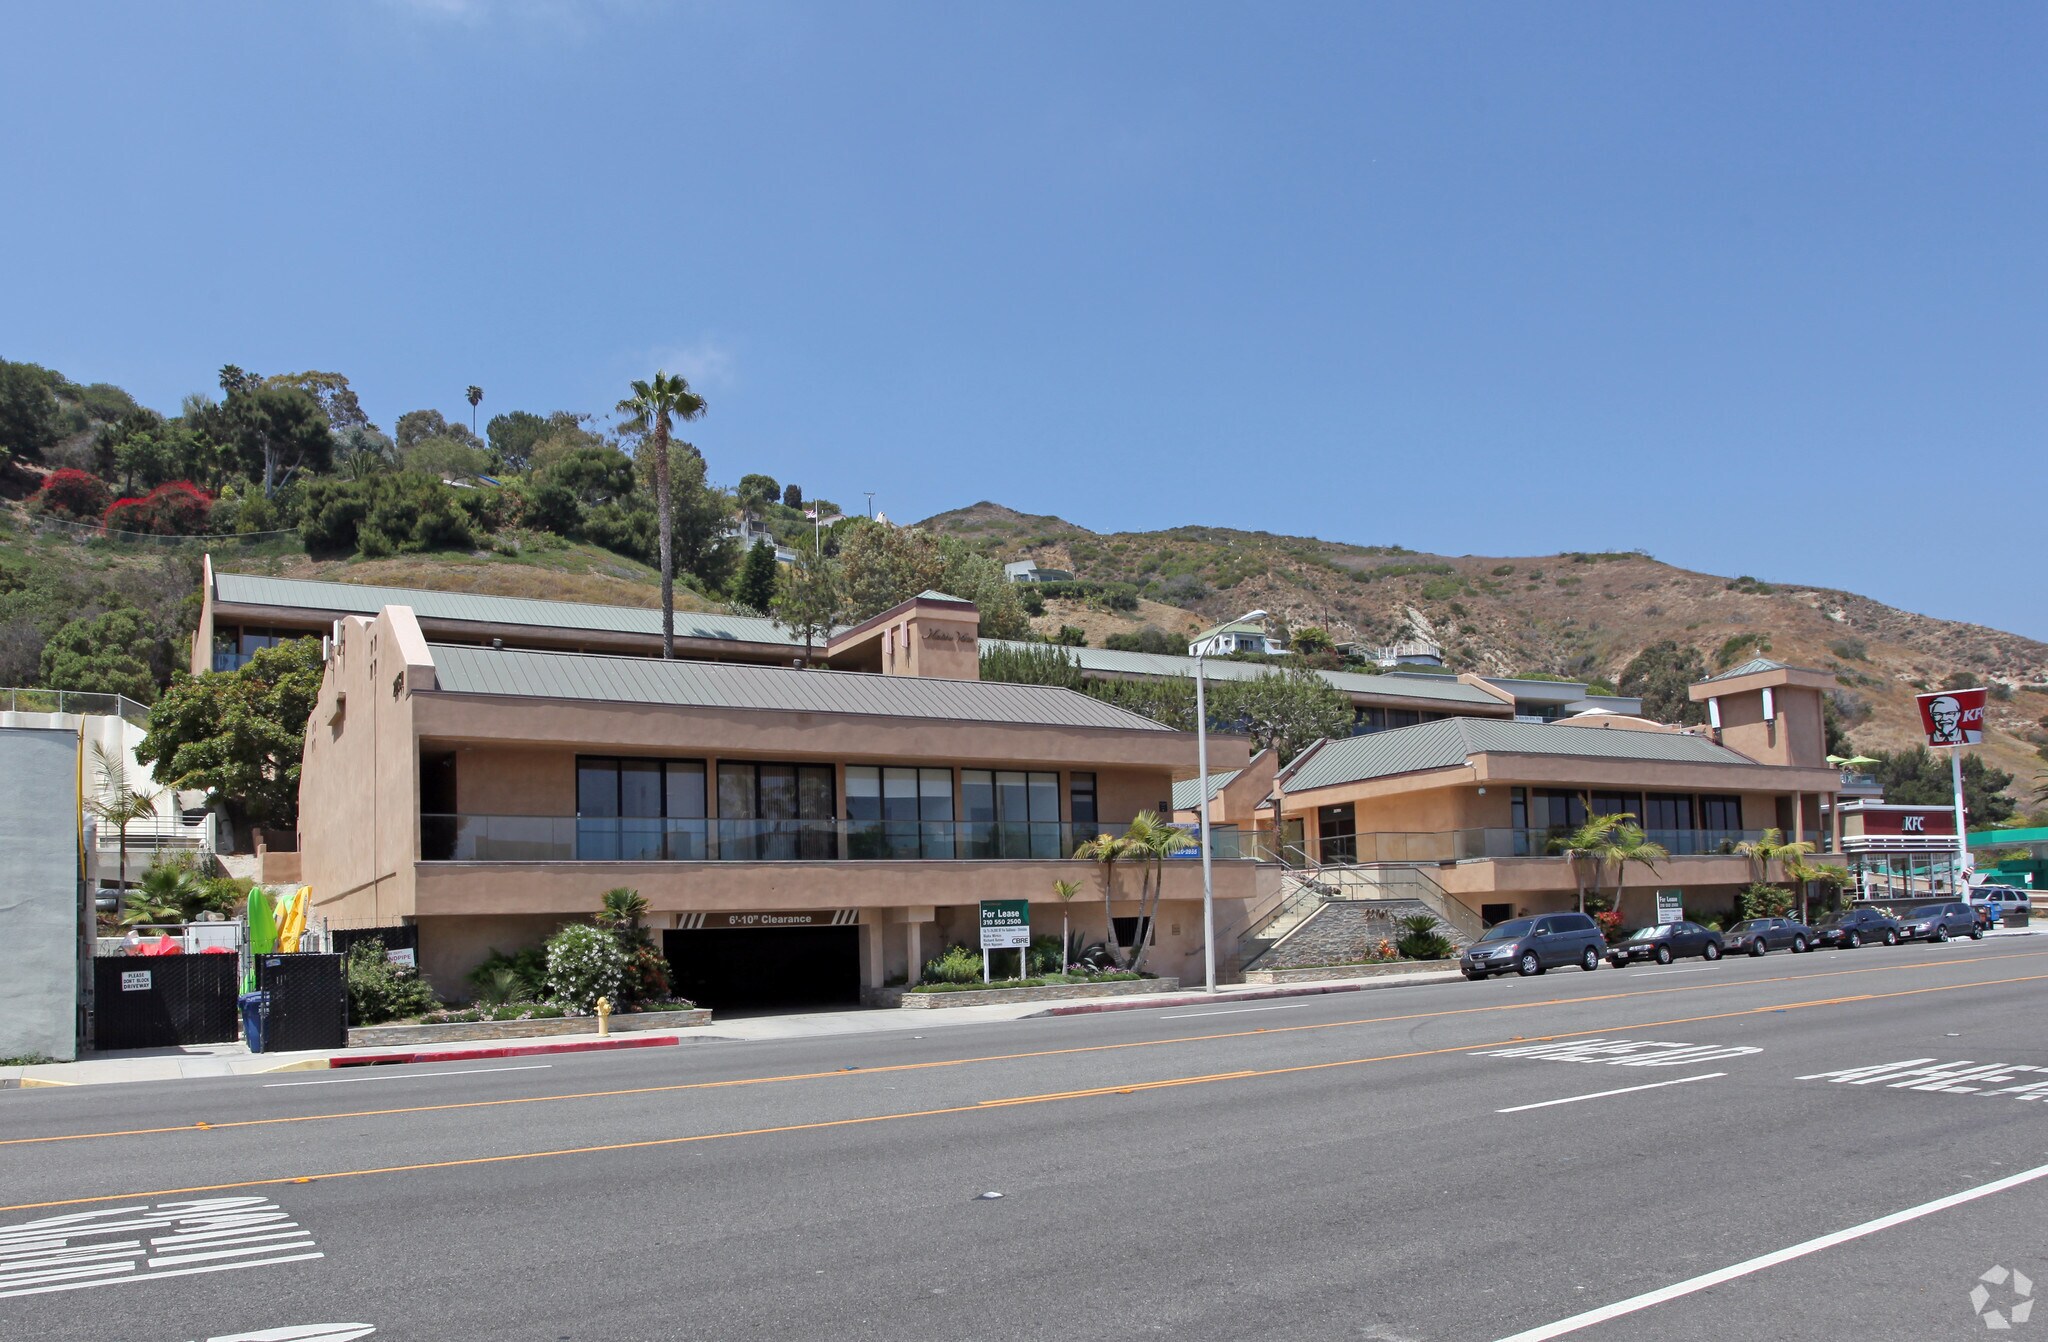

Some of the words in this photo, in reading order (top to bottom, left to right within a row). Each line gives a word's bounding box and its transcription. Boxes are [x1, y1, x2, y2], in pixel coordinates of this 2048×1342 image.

[1905, 816, 1925, 831] KFC
[761, 914, 812, 924] Clearance
[982, 909, 995, 918] For
[997, 909, 1020, 918] Lease
[1465, 1038, 1764, 1067] AHEAD
[1794, 1058, 2048, 1103] AHE
